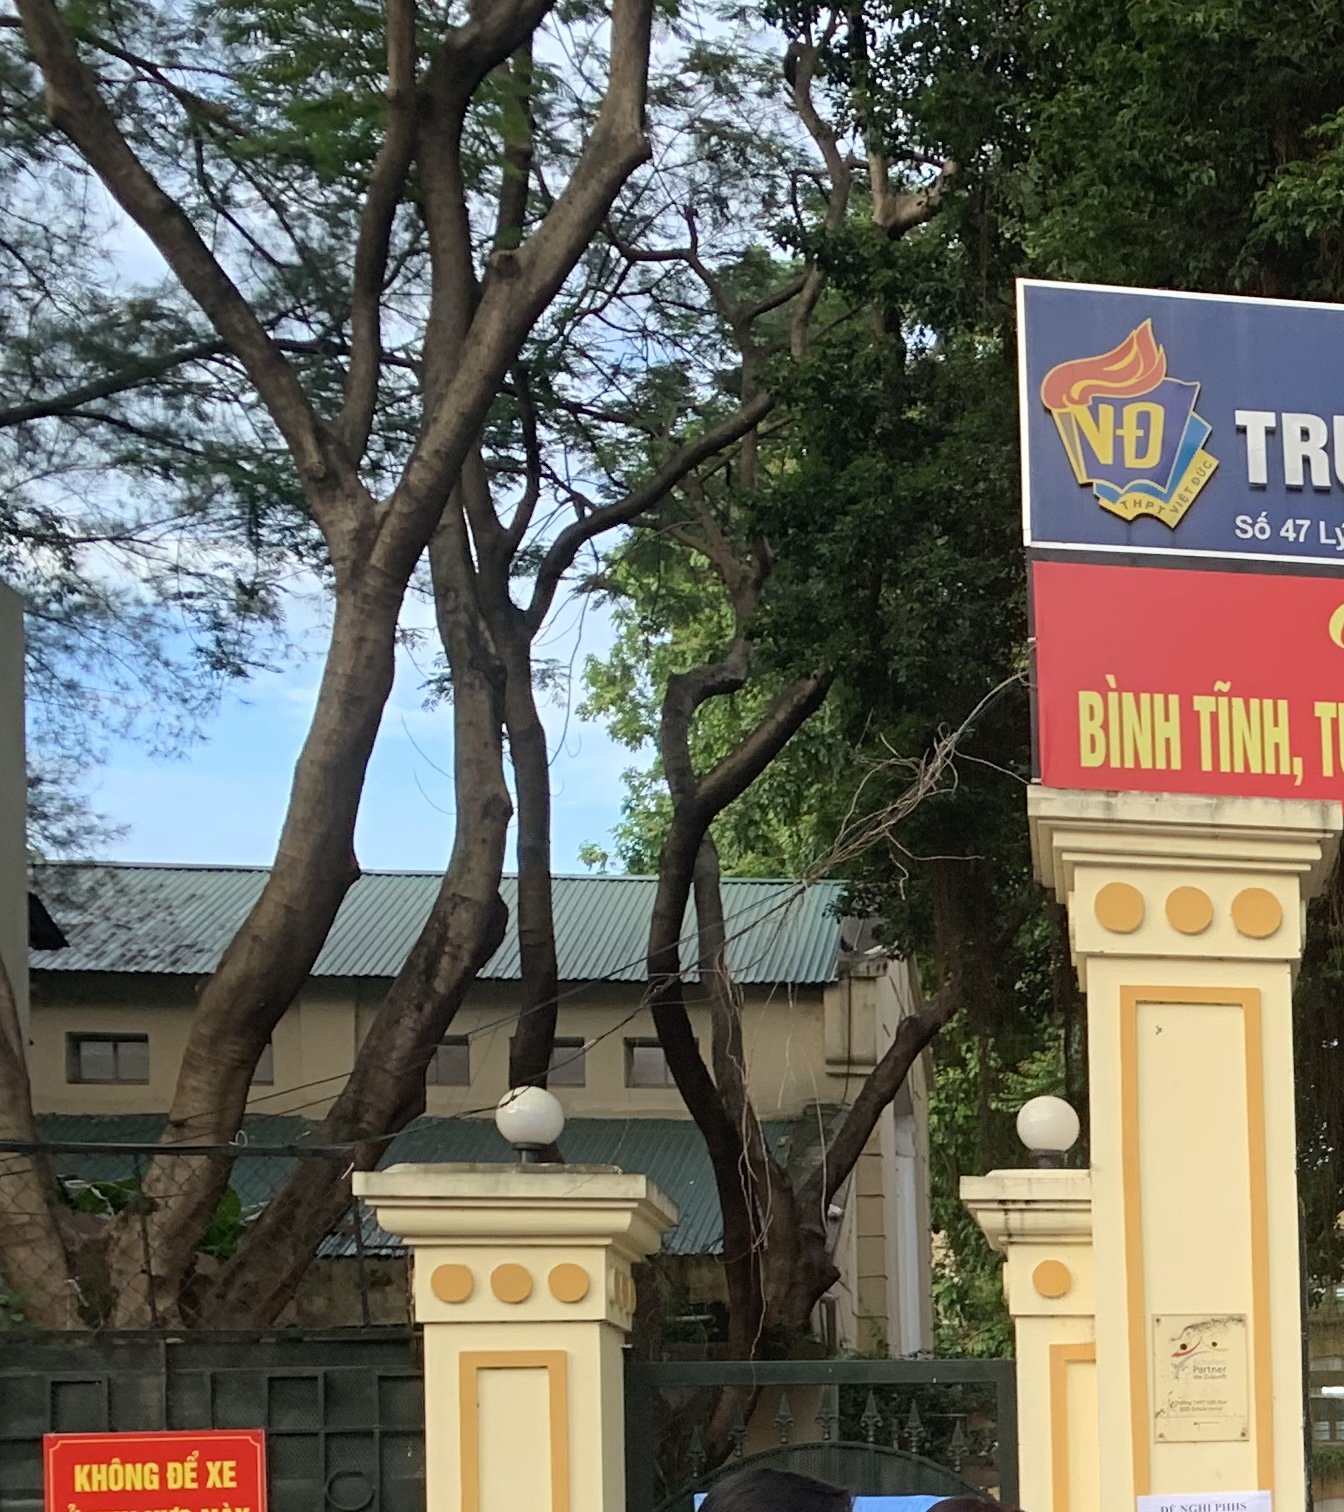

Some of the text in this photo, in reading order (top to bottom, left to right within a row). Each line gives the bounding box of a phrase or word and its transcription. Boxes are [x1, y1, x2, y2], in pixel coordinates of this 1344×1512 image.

[1073, 401, 1165, 469] VĐ
[1120, 499, 1166, 514] THPT
[1170, 486, 1193, 514] VIỆT
[1234, 511, 1271, 541] Số
[1279, 518, 1308, 543] 47
[1078, 673, 1181, 770] BÌNH
[1193, 680, 1304, 787] TĨNH,
[74, 1449, 237, 1492] KHÔNG ĐỂ XE
[1215, 1502, 1247, 1512] PHHS
